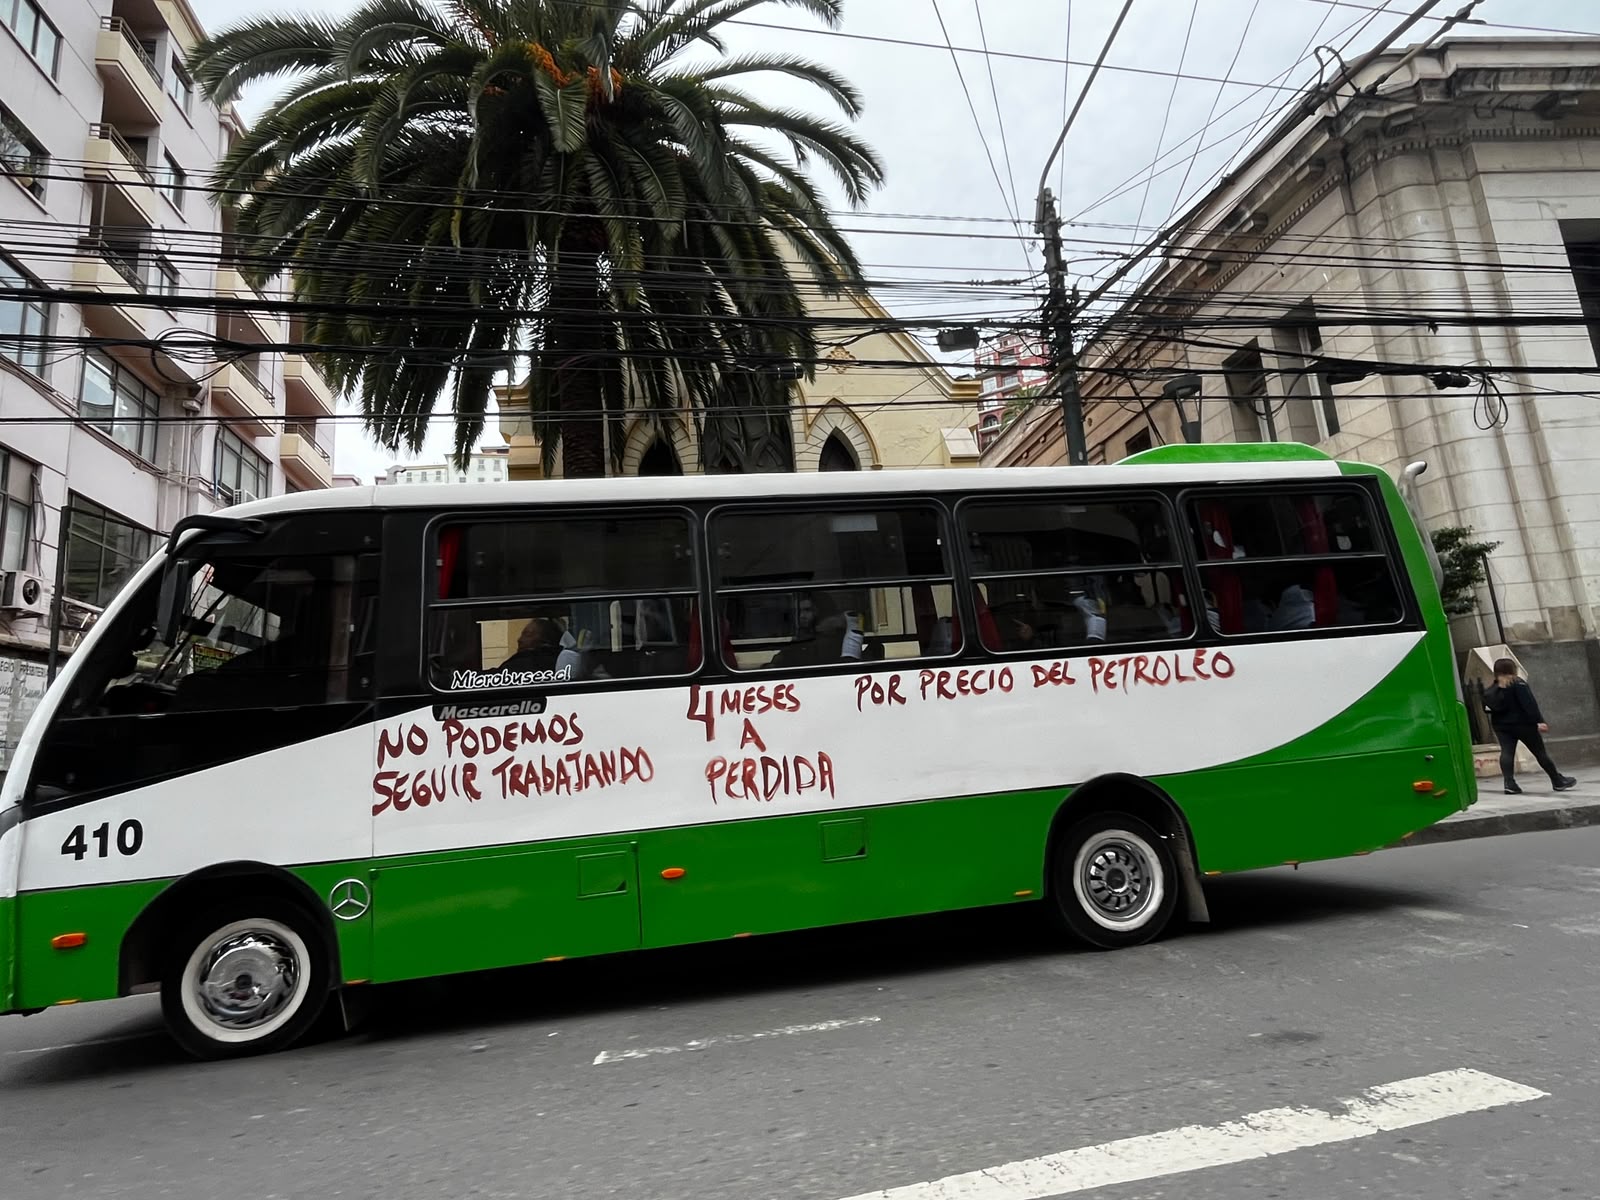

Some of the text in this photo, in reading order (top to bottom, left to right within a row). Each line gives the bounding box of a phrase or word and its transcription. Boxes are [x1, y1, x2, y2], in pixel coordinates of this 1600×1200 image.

[450, 664, 572, 690] Microbuses.cl
[855, 674, 907, 712] POR
[919, 667, 1014, 701] PRECIO
[1031, 661, 1076, 688] DEL
[439, 700, 542, 720] Mascarello
[686, 683, 802, 742] 4 MESES
[740, 718, 767, 753] A
[377, 711, 585, 769] NO PODEMOS
[372, 764, 482, 817] SEGUIR
[705, 750, 836, 806] PERDIDA
[61, 818, 143, 861] 410
